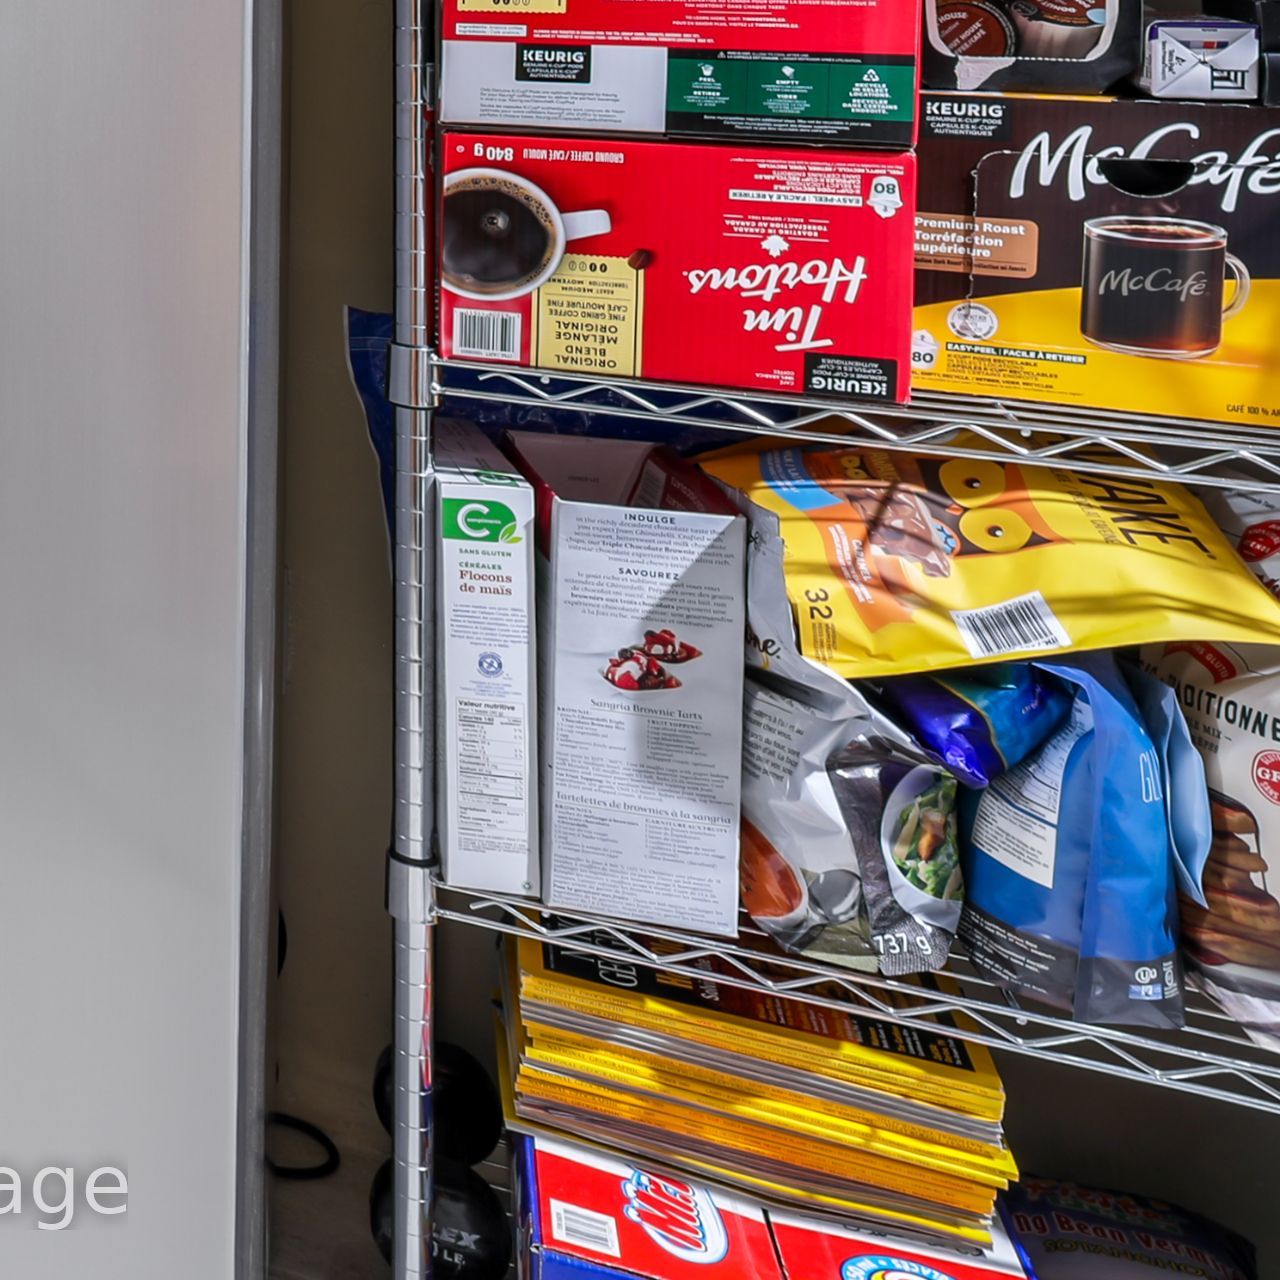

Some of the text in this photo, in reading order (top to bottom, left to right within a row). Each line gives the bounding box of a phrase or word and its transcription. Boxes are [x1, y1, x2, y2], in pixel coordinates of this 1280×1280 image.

[523, 49, 585, 63] KEURIG
[925, 101, 1004, 118] KEURIG
[473, 142, 514, 162] 840 g
[522, 148, 625, 164] GROUND COFFEE CAFÉ MOULU
[873, 182, 897, 195] 80
[731, 191, 861, 205] EASY-PEEL FACILE RETIRER
[914, 216, 1026, 236] Premium Roast
[914, 229, 1004, 248] Torréfaction
[914, 241, 991, 258] supérieure
[682, 255, 868, 304] Hortons
[1098, 267, 1208, 303] McCafé
[547, 299, 628, 314] CAFÉ MOUTURE FINE
[548, 308, 626, 322] FINE GRIND COFFEE
[555, 320, 618, 334] ORIGINAL
[742, 304, 834, 352] Tim
[554, 331, 618, 345] MÉLANGE
[564, 345, 607, 357] BLEND
[912, 351, 934, 364] 80
[947, 343, 1085, 364] EASY-PEEL FACILE RETIRER
[554, 354, 617, 369] ORIGINAL
[810, 376, 888, 396] KEURIG
[1226, 403, 1245, 414] CAFÉ
[624, 513, 677, 525] INDULGE
[458, 547, 512, 558] SANS GLUTEN
[458, 560, 503, 571] CÉRÉALES
[459, 569, 513, 583] Flocons
[618, 567, 680, 581] SAVOUREZ
[459, 582, 513, 596] de maïs
[805, 587, 833, 620] 32
[590, 698, 676, 718] Sangria Brownie
[555, 790, 670, 817] Tartelettes de brownies
[873, 933, 932, 955] 737 g
[1053, 1209, 1130, 1245] Bean
